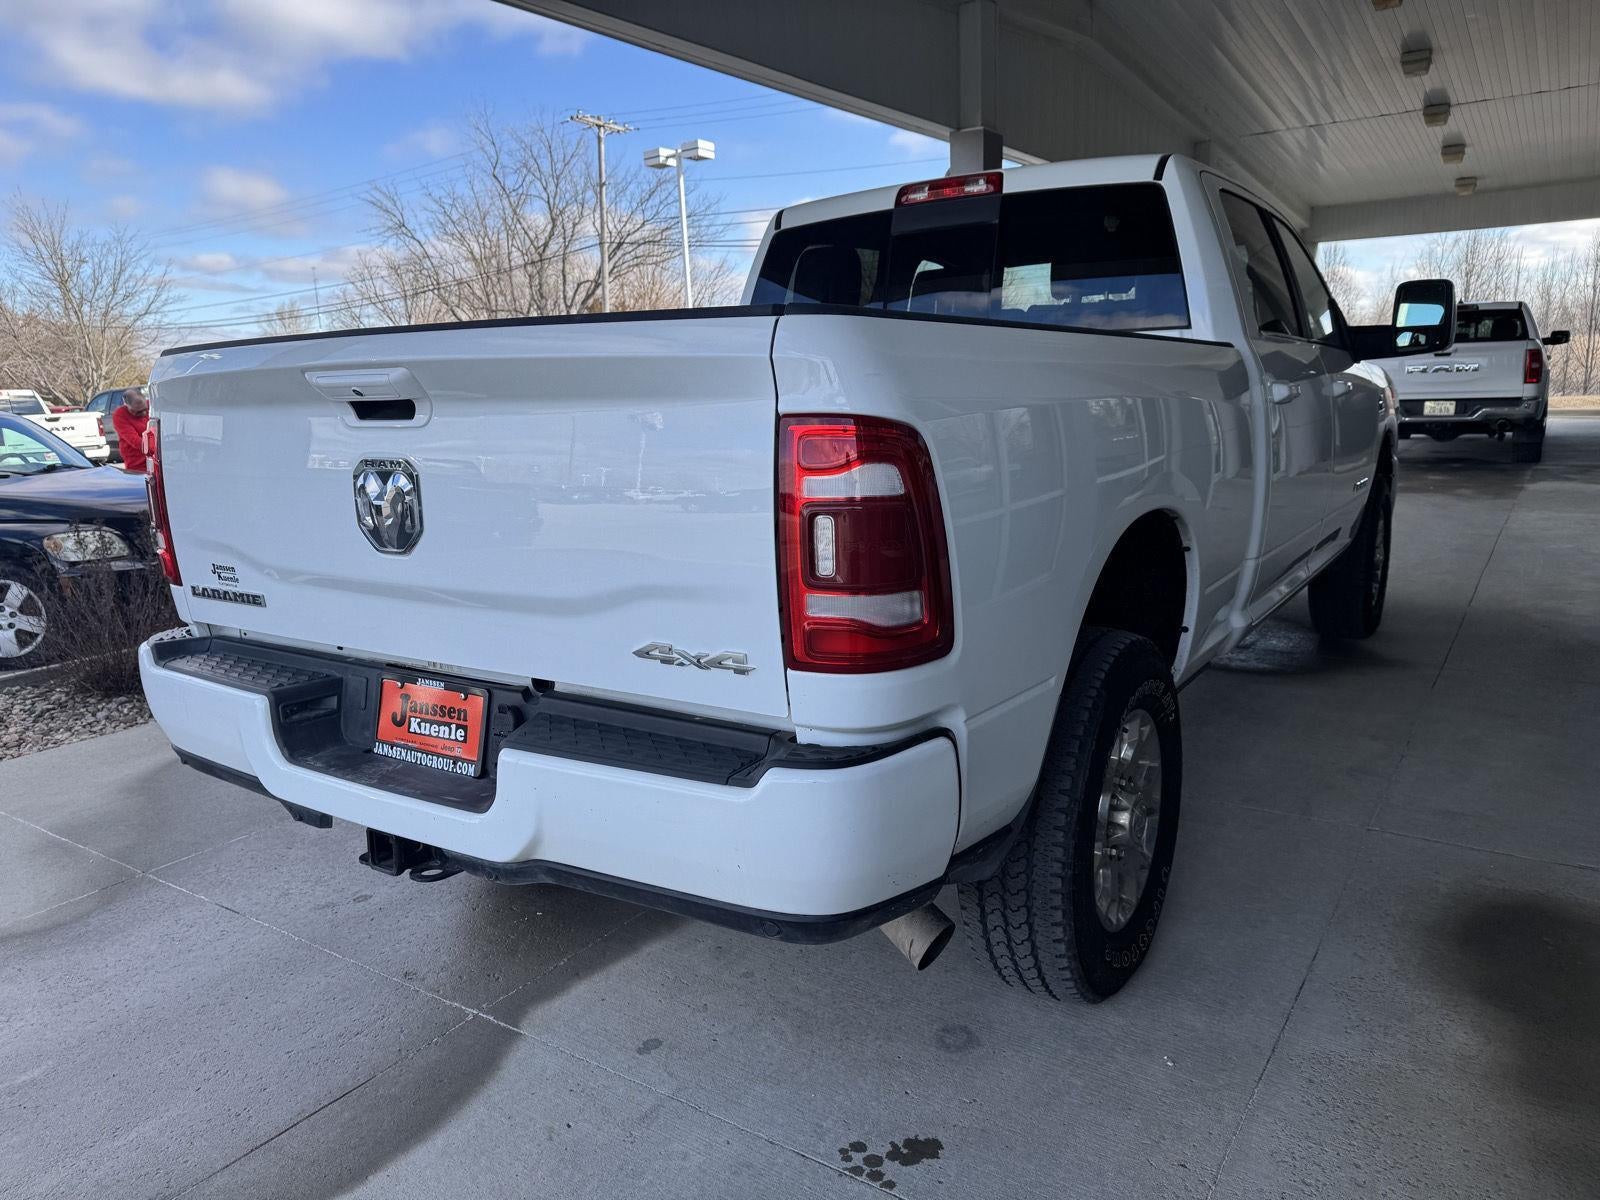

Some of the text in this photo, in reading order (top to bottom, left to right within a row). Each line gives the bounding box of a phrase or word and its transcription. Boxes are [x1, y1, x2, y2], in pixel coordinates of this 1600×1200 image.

[1405, 363, 1479, 374] RAM
[364, 460, 403, 471] RAM
[211, 563, 236, 574] Janssen
[190, 585, 265, 607] LARAMIE
[416, 678, 445, 688] JANSSEN
[391, 693, 468, 728] Janssen
[409, 717, 465, 741] Kuenle
